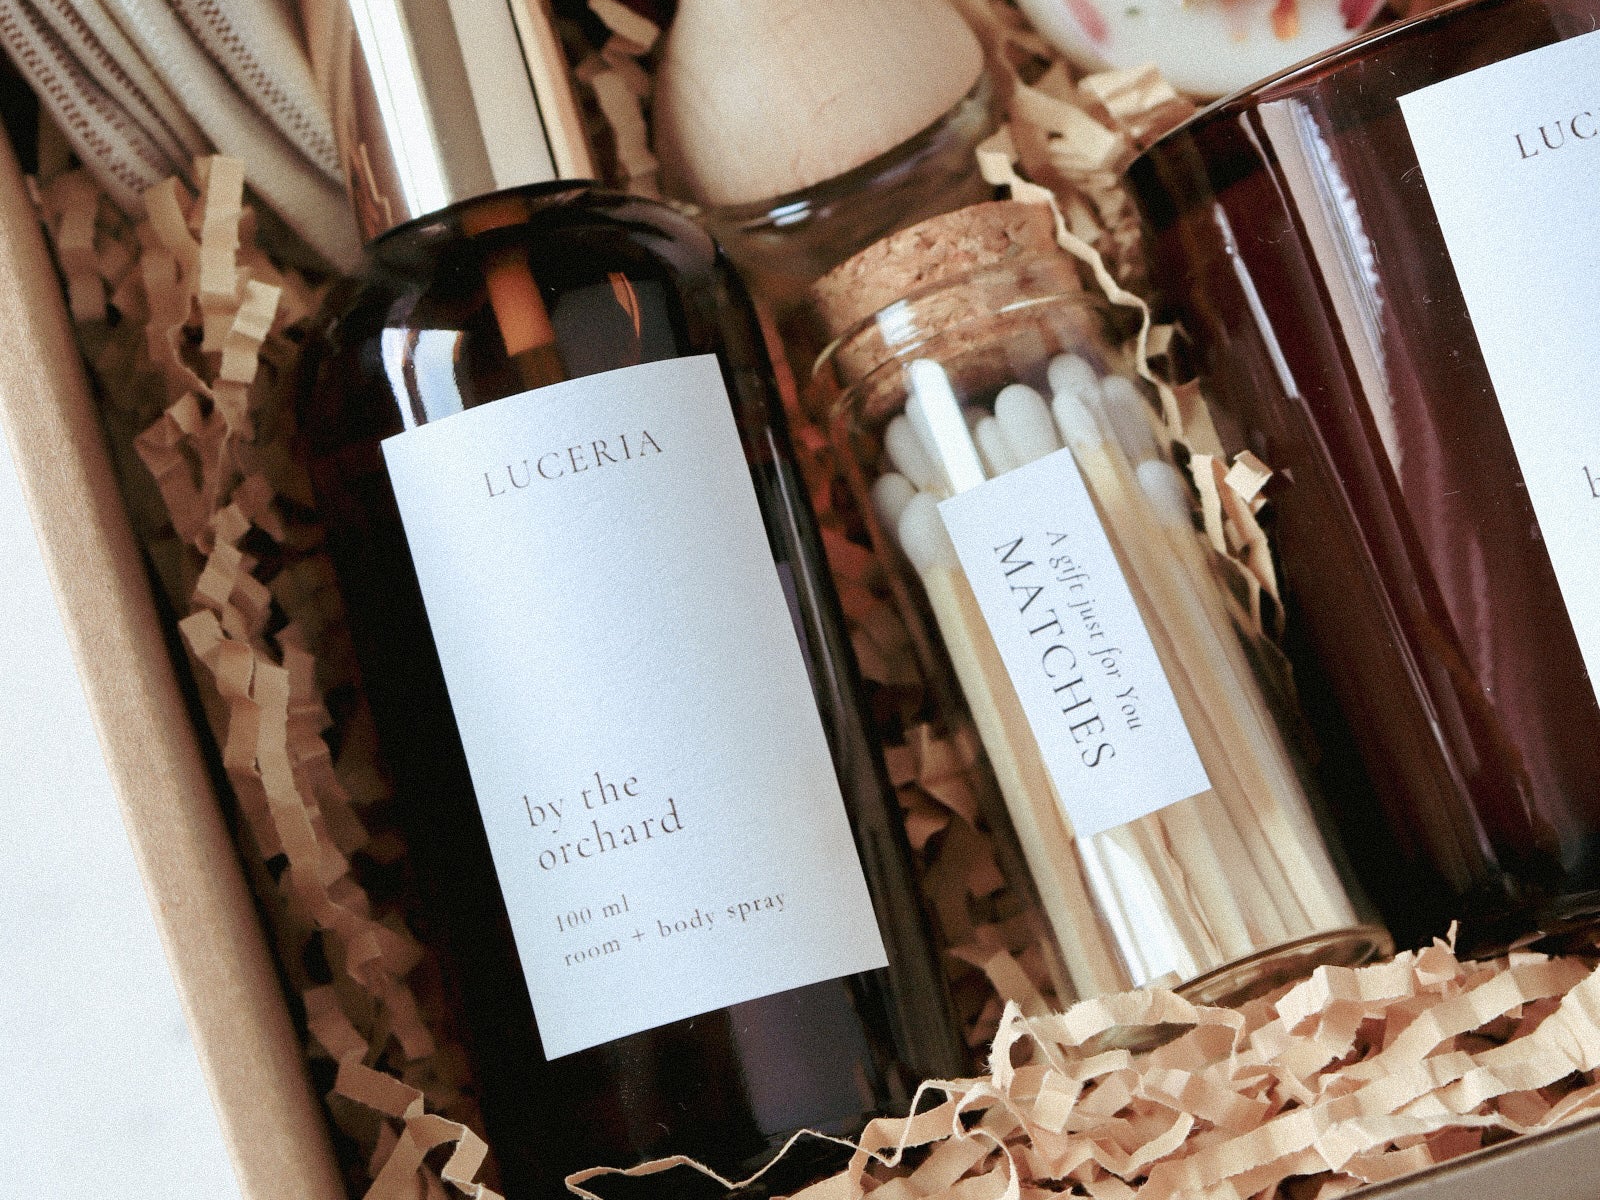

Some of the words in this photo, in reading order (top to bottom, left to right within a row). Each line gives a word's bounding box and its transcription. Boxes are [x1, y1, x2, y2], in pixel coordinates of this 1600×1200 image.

[484, 430, 664, 497] LUCERIA
[1046, 531, 1068, 547] A
[1048, 555, 1090, 593] gift
[1068, 599, 1104, 639] just
[993, 535, 1116, 768] MATCHES
[1090, 647, 1122, 678] for
[1116, 686, 1143, 731] You
[523, 795, 563, 834] by
[581, 771, 639, 810] the
[538, 797, 684, 871] orchard
[556, 906, 592, 932] 100
[602, 894, 630, 919] ml
[564, 938, 621, 967] room
[656, 908, 716, 938] body
[726, 891, 786, 922] spray
